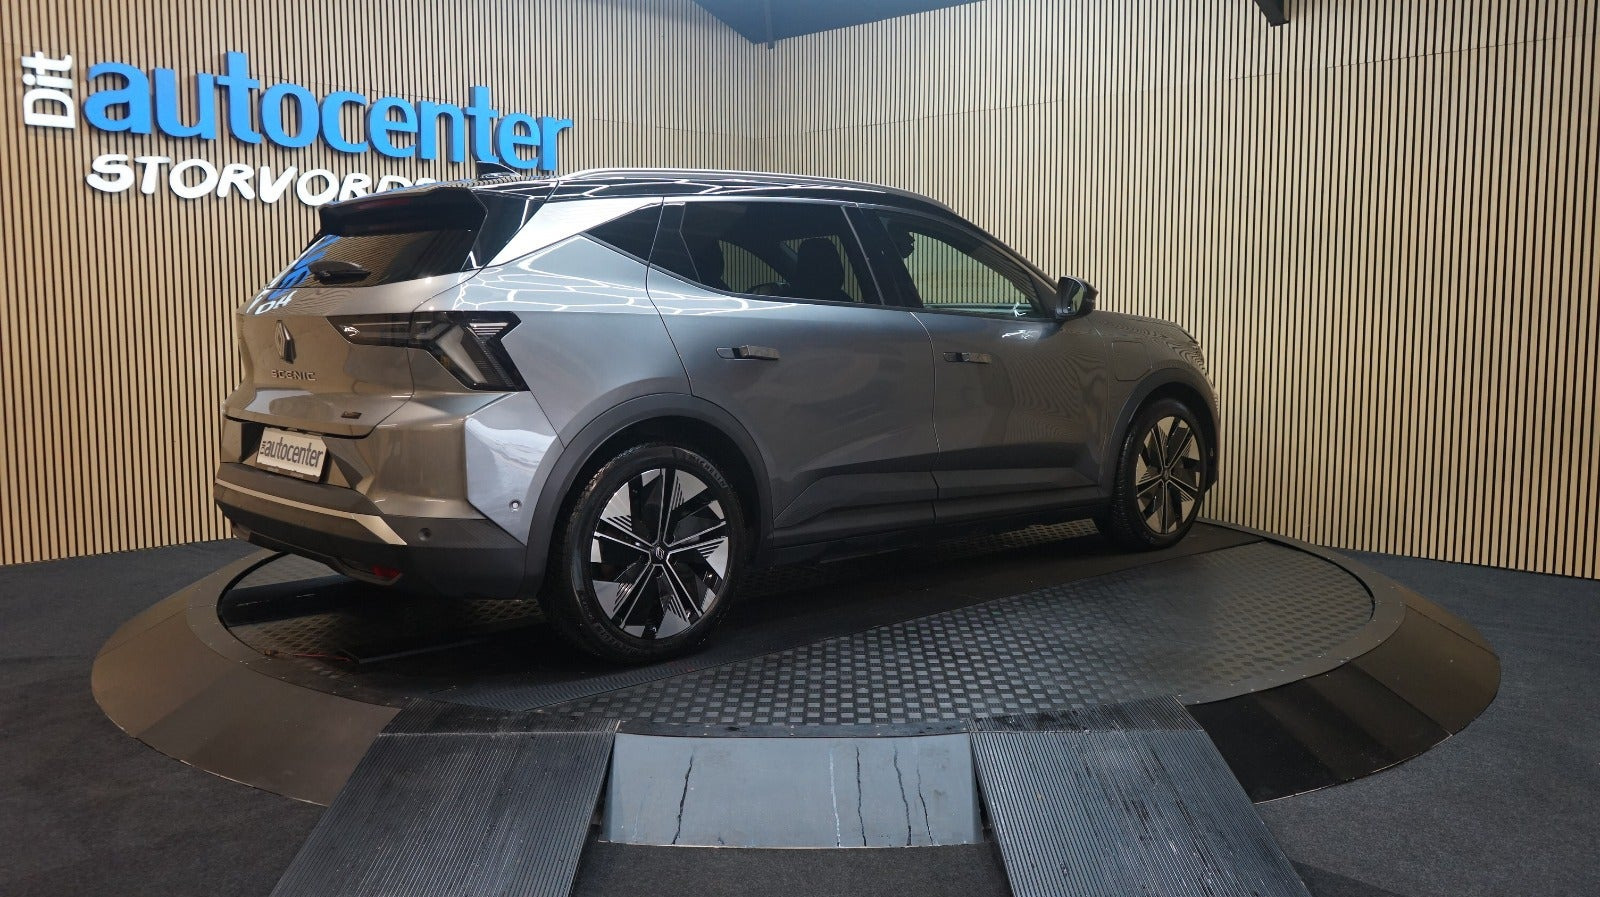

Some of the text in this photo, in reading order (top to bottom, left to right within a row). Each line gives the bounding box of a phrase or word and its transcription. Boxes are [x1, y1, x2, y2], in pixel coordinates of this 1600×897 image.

[21, 50, 573, 171] Dit autocenter
[86, 153, 439, 206] STORVOR
[271, 369, 317, 381] SCENIC
[264, 436, 324, 468] autocenter
